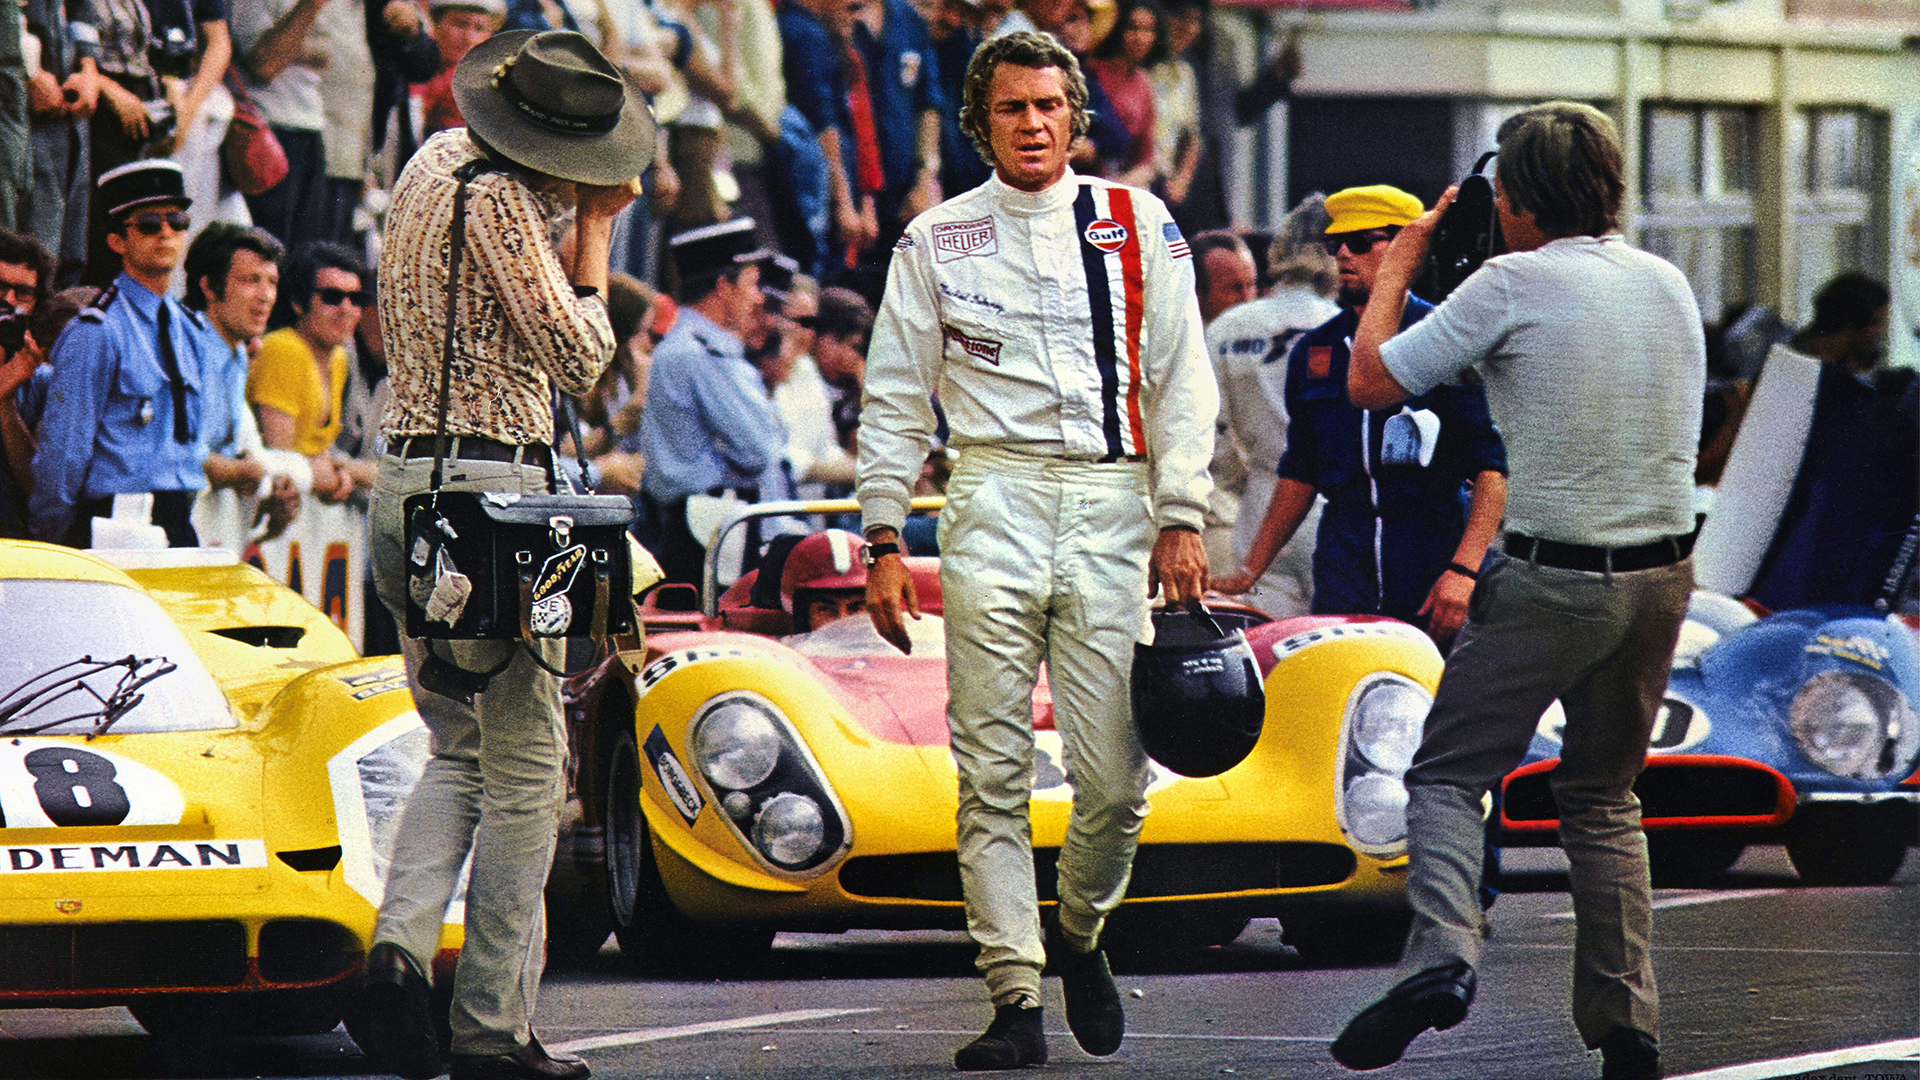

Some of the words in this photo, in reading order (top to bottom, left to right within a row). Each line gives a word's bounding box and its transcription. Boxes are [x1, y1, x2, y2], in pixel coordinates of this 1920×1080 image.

[942, 231, 989, 250] HEUER
[1088, 228, 1124, 240] Gulf
[533, 549, 583, 600] GOODYEAR
[0, 746, 131, 827] 8
[0, 844, 241, 871] DEMAN
